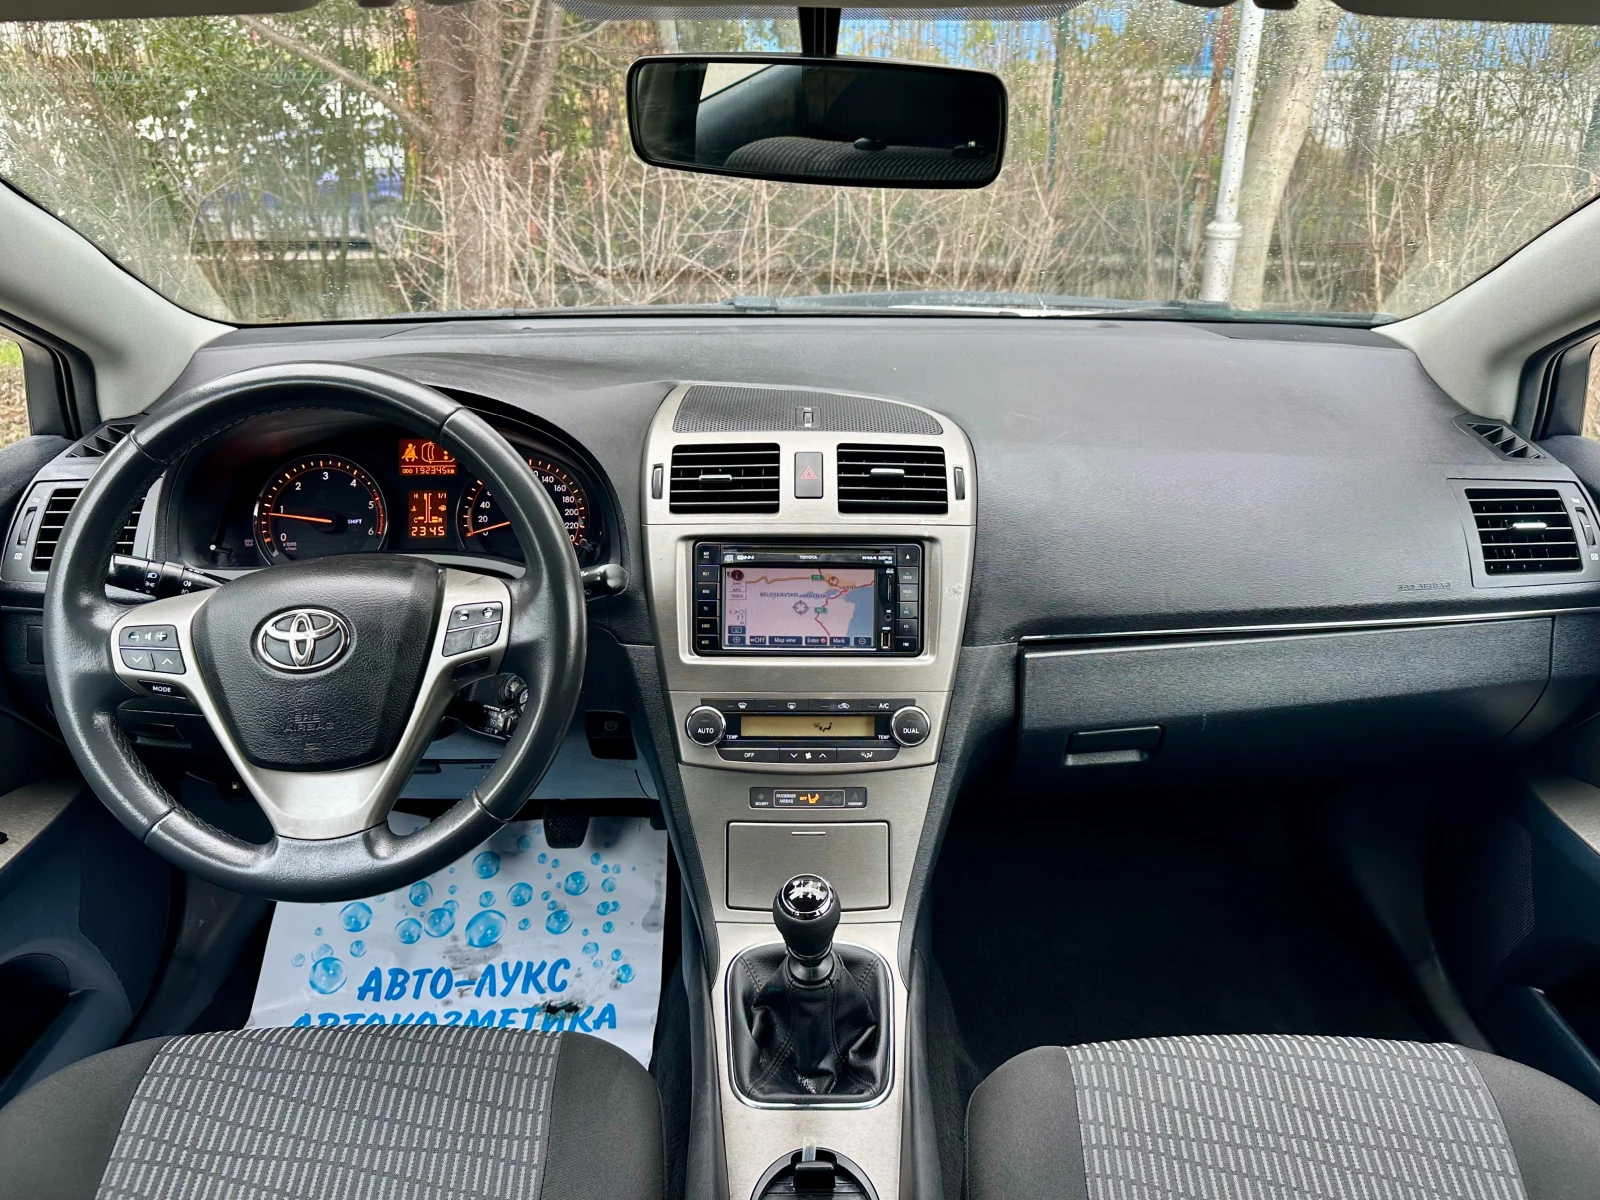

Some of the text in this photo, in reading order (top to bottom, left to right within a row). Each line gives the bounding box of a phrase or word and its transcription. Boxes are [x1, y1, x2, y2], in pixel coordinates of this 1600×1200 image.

[415, 467, 447, 475] 192345
[322, 471, 329, 481] 3
[541, 475, 555, 484] 140
[295, 481, 302, 491] 2
[350, 479, 357, 488] 4
[553, 484, 567, 492] 160
[562, 495, 575, 503] 180
[368, 501, 375, 510] 5
[480, 501, 491, 509] 40
[279, 505, 285, 514] 1
[564, 508, 579, 516] 200
[478, 515, 488, 523] 20
[367, 526, 375, 536] 6
[280, 533, 287, 541] 0
[152, 685, 172, 693] MODE
[357, 958, 571, 1002] АВТО-ЛУКС
